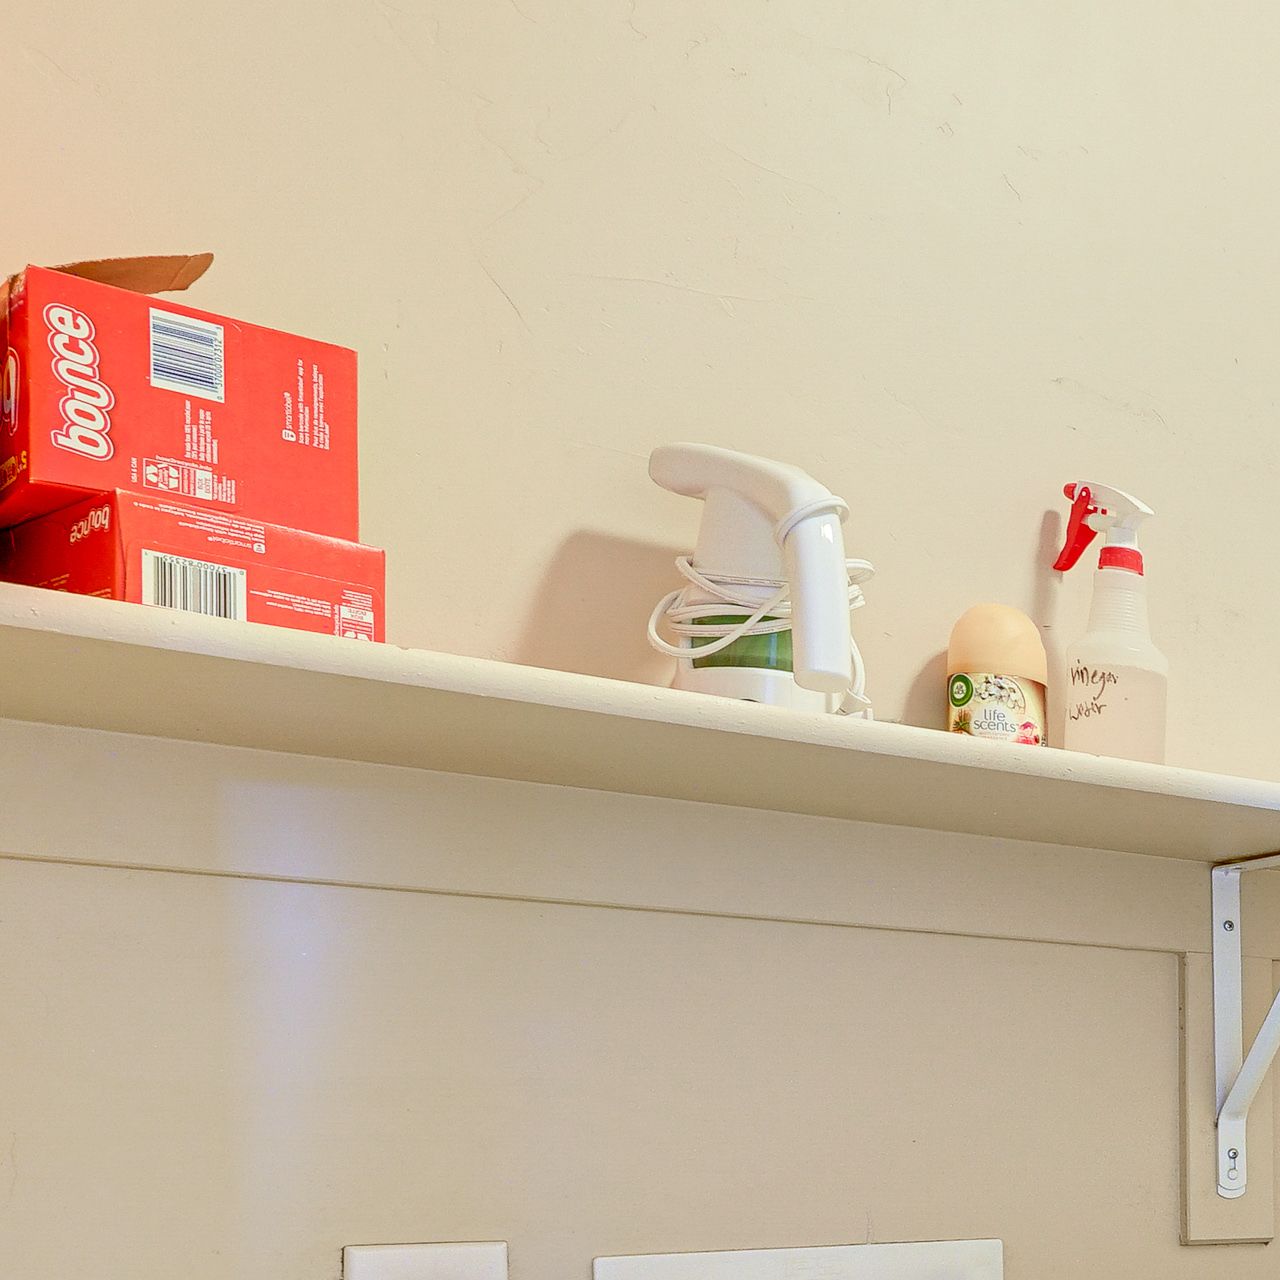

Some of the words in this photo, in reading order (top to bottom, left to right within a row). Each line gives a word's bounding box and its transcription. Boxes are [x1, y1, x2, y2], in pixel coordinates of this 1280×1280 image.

[44, 304, 115, 460] bounce
[70, 505, 110, 545] bounce
[984, 709, 1006, 721] life
